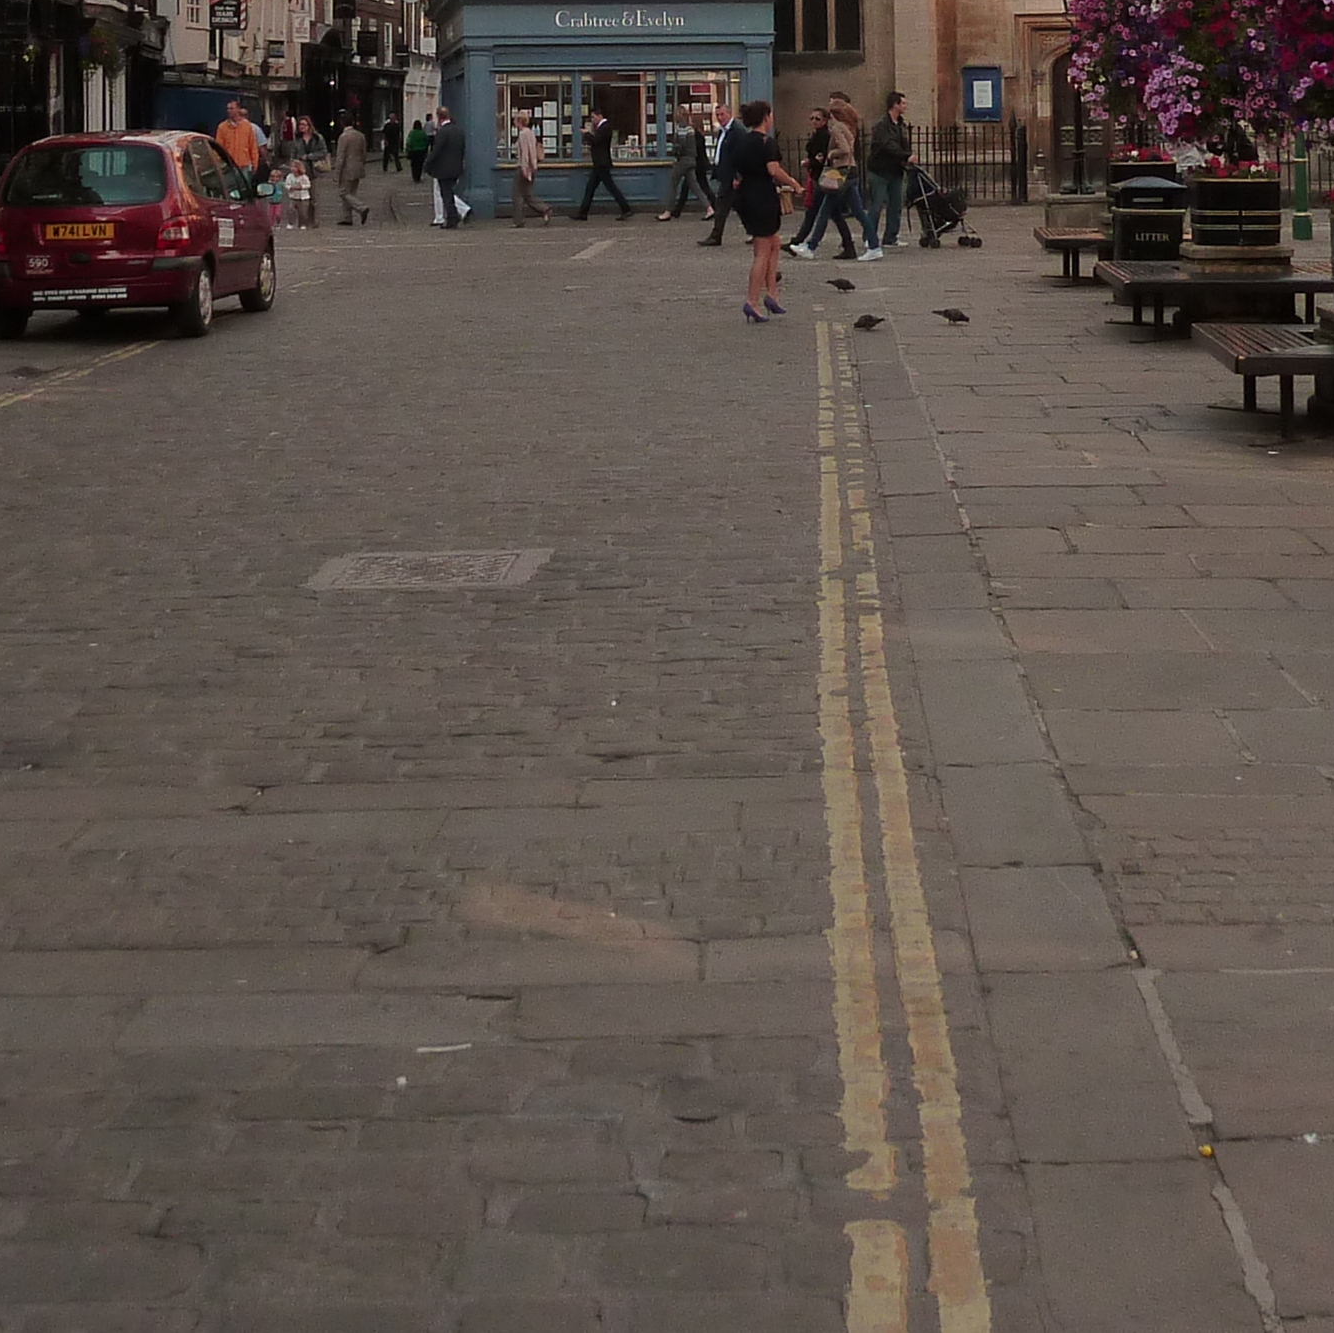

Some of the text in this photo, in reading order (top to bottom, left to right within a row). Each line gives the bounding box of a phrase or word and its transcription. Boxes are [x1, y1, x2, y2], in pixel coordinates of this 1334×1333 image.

[555, 9, 685, 31] Crabtree & Evelyn
[82, 223, 107, 237] LVN
[1134, 232, 1170, 242] LITTER
[28, 258, 49, 267] 590
